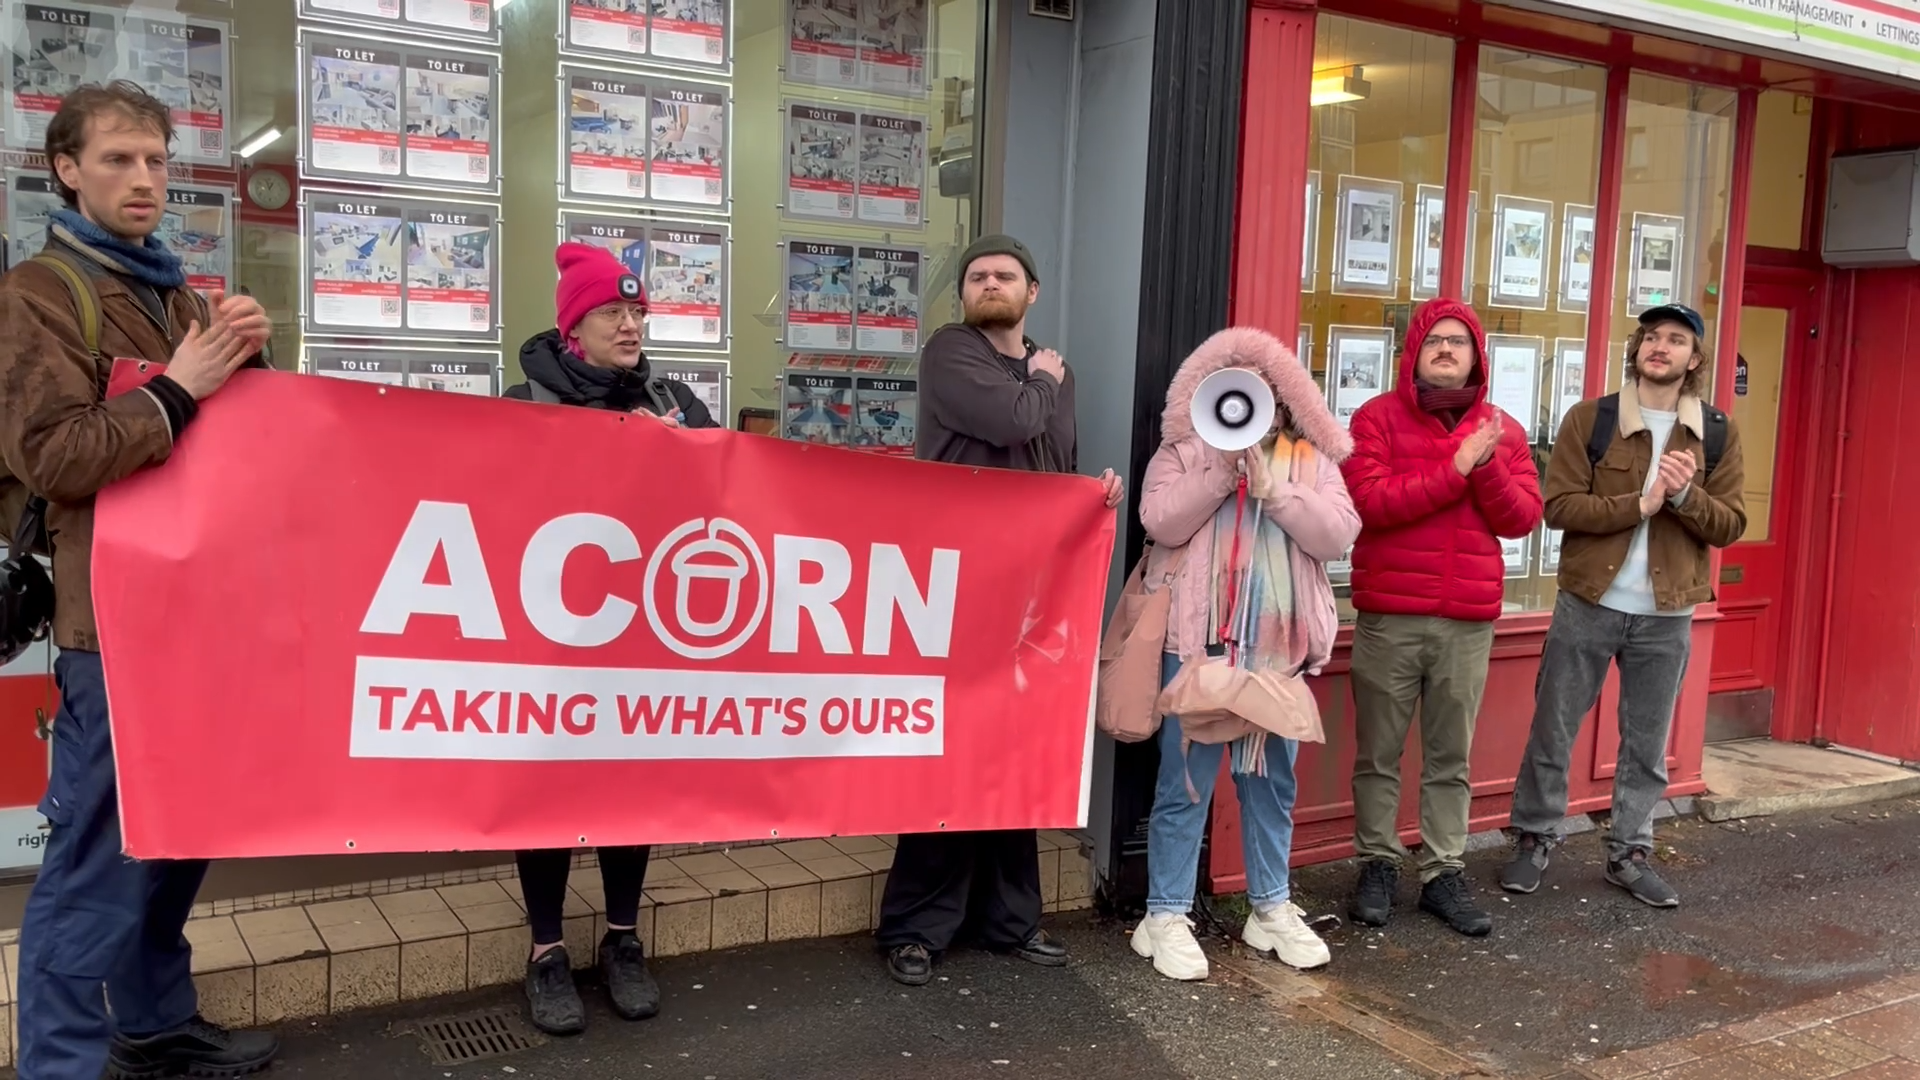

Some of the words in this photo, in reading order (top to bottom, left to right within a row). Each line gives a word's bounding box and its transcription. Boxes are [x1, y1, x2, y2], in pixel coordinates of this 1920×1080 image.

[40, 9, 58, 22] TO
[62, 12, 87, 25] LET
[1778, 0, 1854, 29] MANAGEMENT
[1876, 21, 1920, 46] LETTINGS
[151, 24, 168, 36] TO
[172, 27, 195, 39] LET
[336, 48, 351, 59] TO
[355, 50, 375, 61] LET
[428, 60, 442, 70] TO
[446, 62, 465, 72] LET
[592, 82, 605, 92] TO
[608, 84, 626, 93] LET
[671, 91, 683, 101] TO
[686, 93, 703, 103] LET
[808, 110, 820, 119] TO
[822, 112, 838, 121] LET
[876, 118, 887, 127] TO
[890, 120, 905, 129] LET
[174, 193, 197, 204] LET
[338, 203, 353, 214] TO
[357, 205, 377, 215] LET
[430, 213, 445, 224] TO
[448, 215, 467, 225] LET
[591, 226, 604, 236] TO
[608, 227, 625, 238] LET
[668, 233, 681, 242] TO
[683, 234, 700, 244] LET
[806, 245, 818, 254] TO
[820, 246, 836, 255] LET
[875, 251, 886, 260] TO
[888, 251, 903, 261] LET
[341, 360, 357, 370] TO
[360, 361, 380, 371] LET
[431, 364, 446, 373] TO
[449, 364, 468, 374] LET
[668, 372, 680, 381] TO
[682, 373, 699, 382] LET
[805, 378, 817, 387] TO
[819, 378, 835, 388] LET
[873, 381, 884, 390] TO
[886, 382, 901, 391] LET
[359, 500, 960, 660] ACORN
[369, 686, 598, 735] TAKING
[617, 694, 807, 737] WHAT'S
[819, 696, 935, 736] OURS
